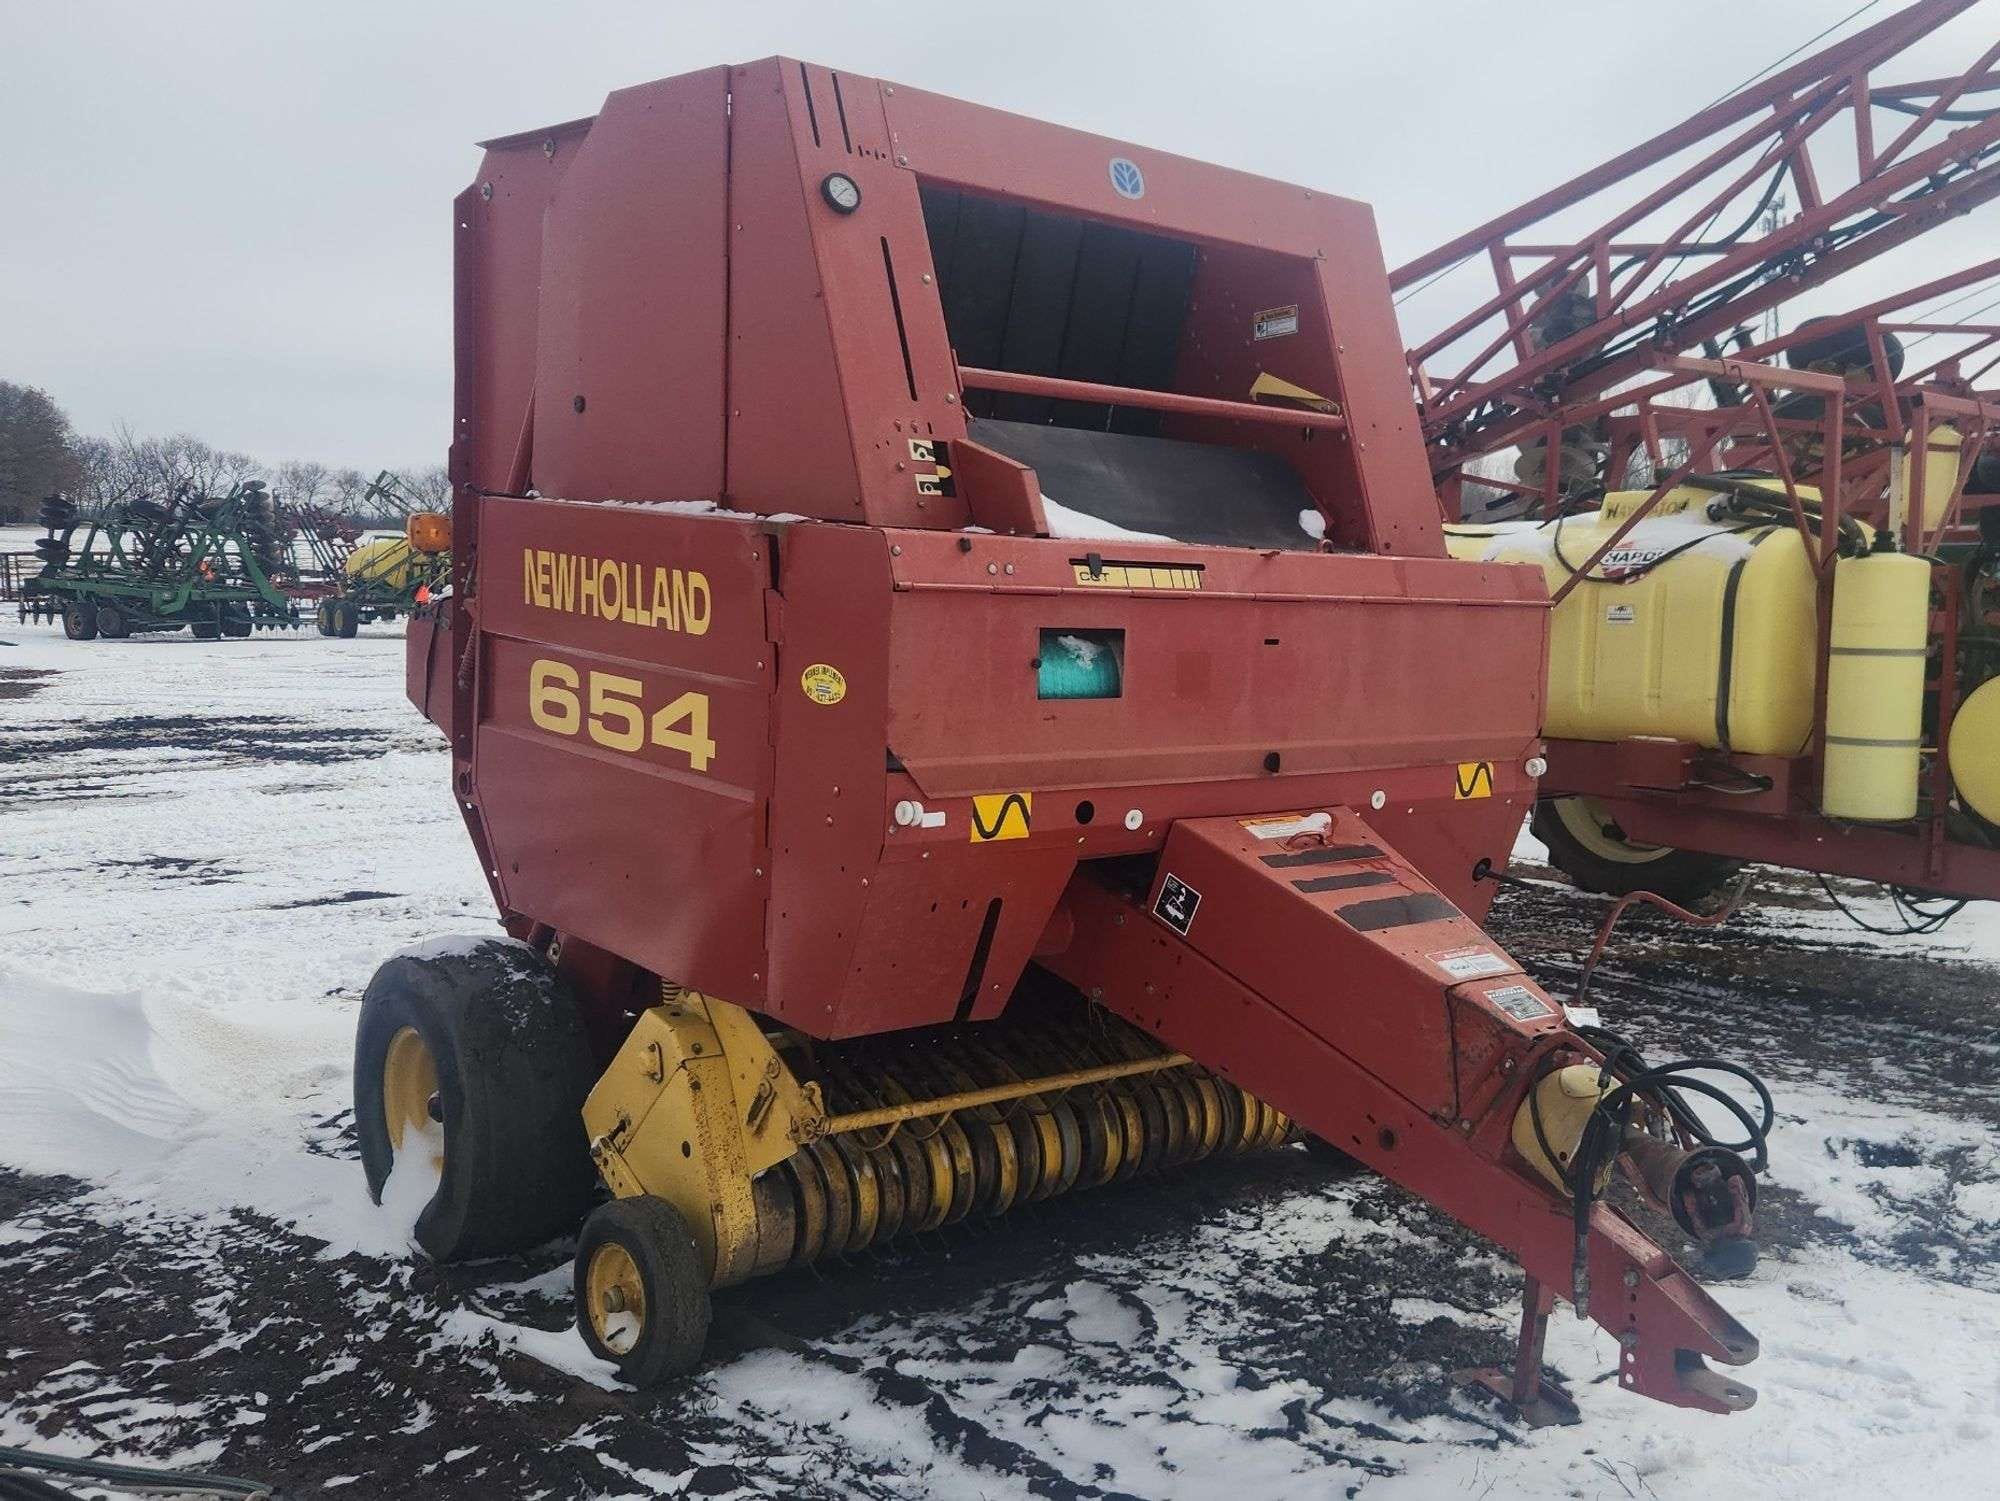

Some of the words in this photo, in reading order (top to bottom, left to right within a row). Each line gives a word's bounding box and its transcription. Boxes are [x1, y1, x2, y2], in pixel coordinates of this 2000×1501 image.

[524, 548, 577, 612] NEW
[581, 556, 711, 635] HOLLAND
[530, 659, 716, 772] 654
